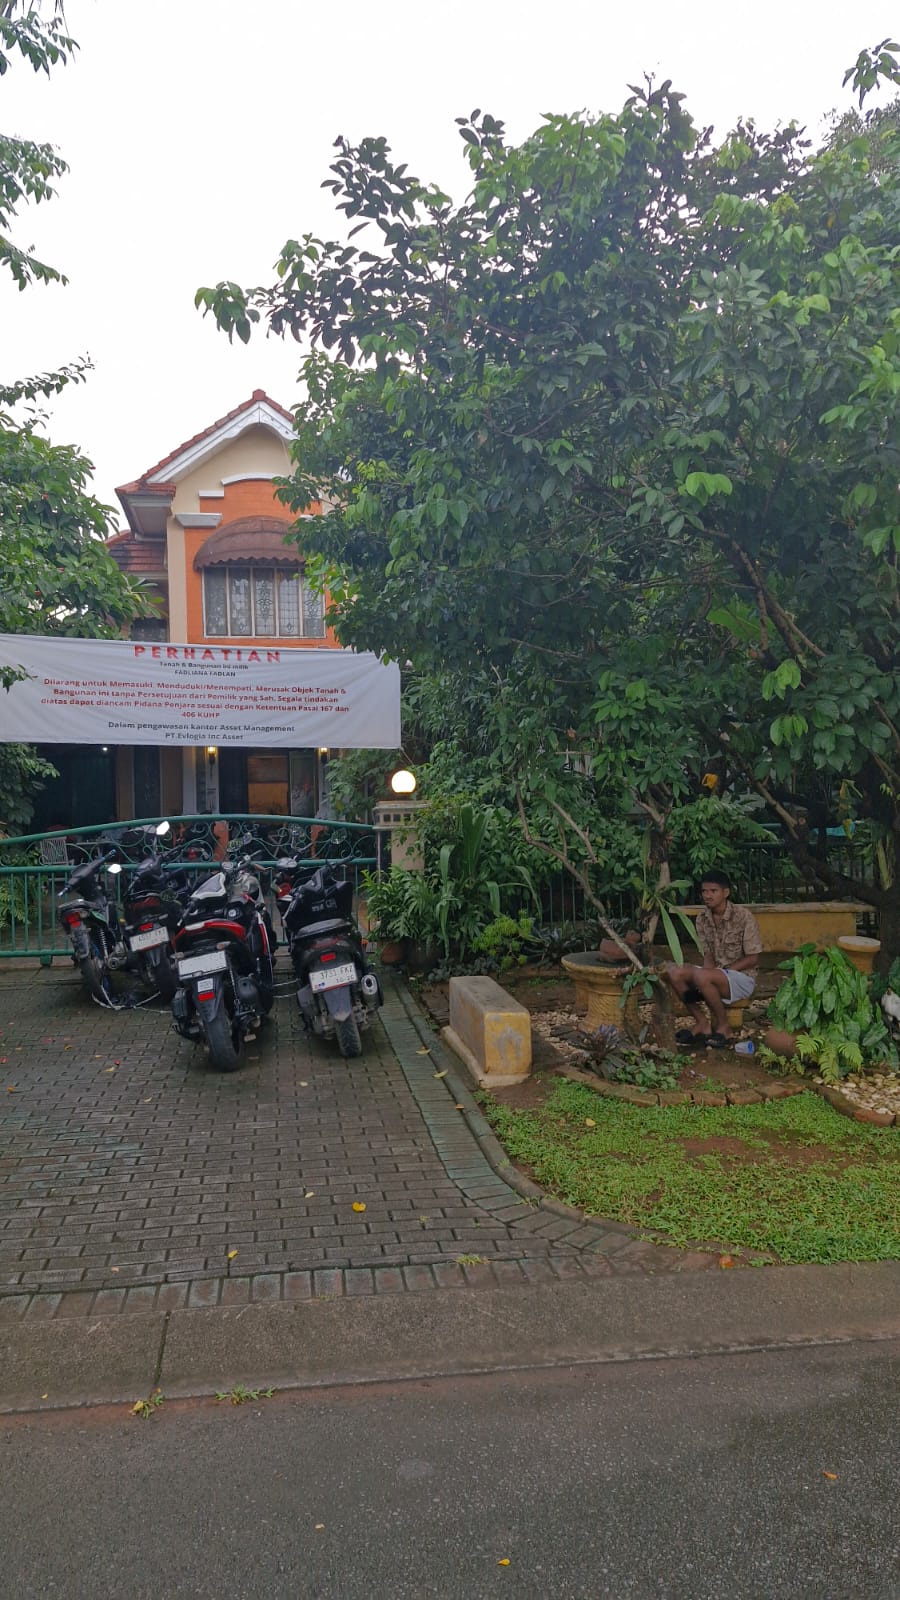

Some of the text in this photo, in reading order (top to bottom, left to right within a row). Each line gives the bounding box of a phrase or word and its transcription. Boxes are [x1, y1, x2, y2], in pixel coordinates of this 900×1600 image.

[134, 645, 280, 662] PERHATIAN
[44, 678, 80, 687] Dilarang
[292, 686, 314, 694] Objek
[54, 688, 96, 697] Bangunan
[138, 692, 187, 700] Persetujuan
